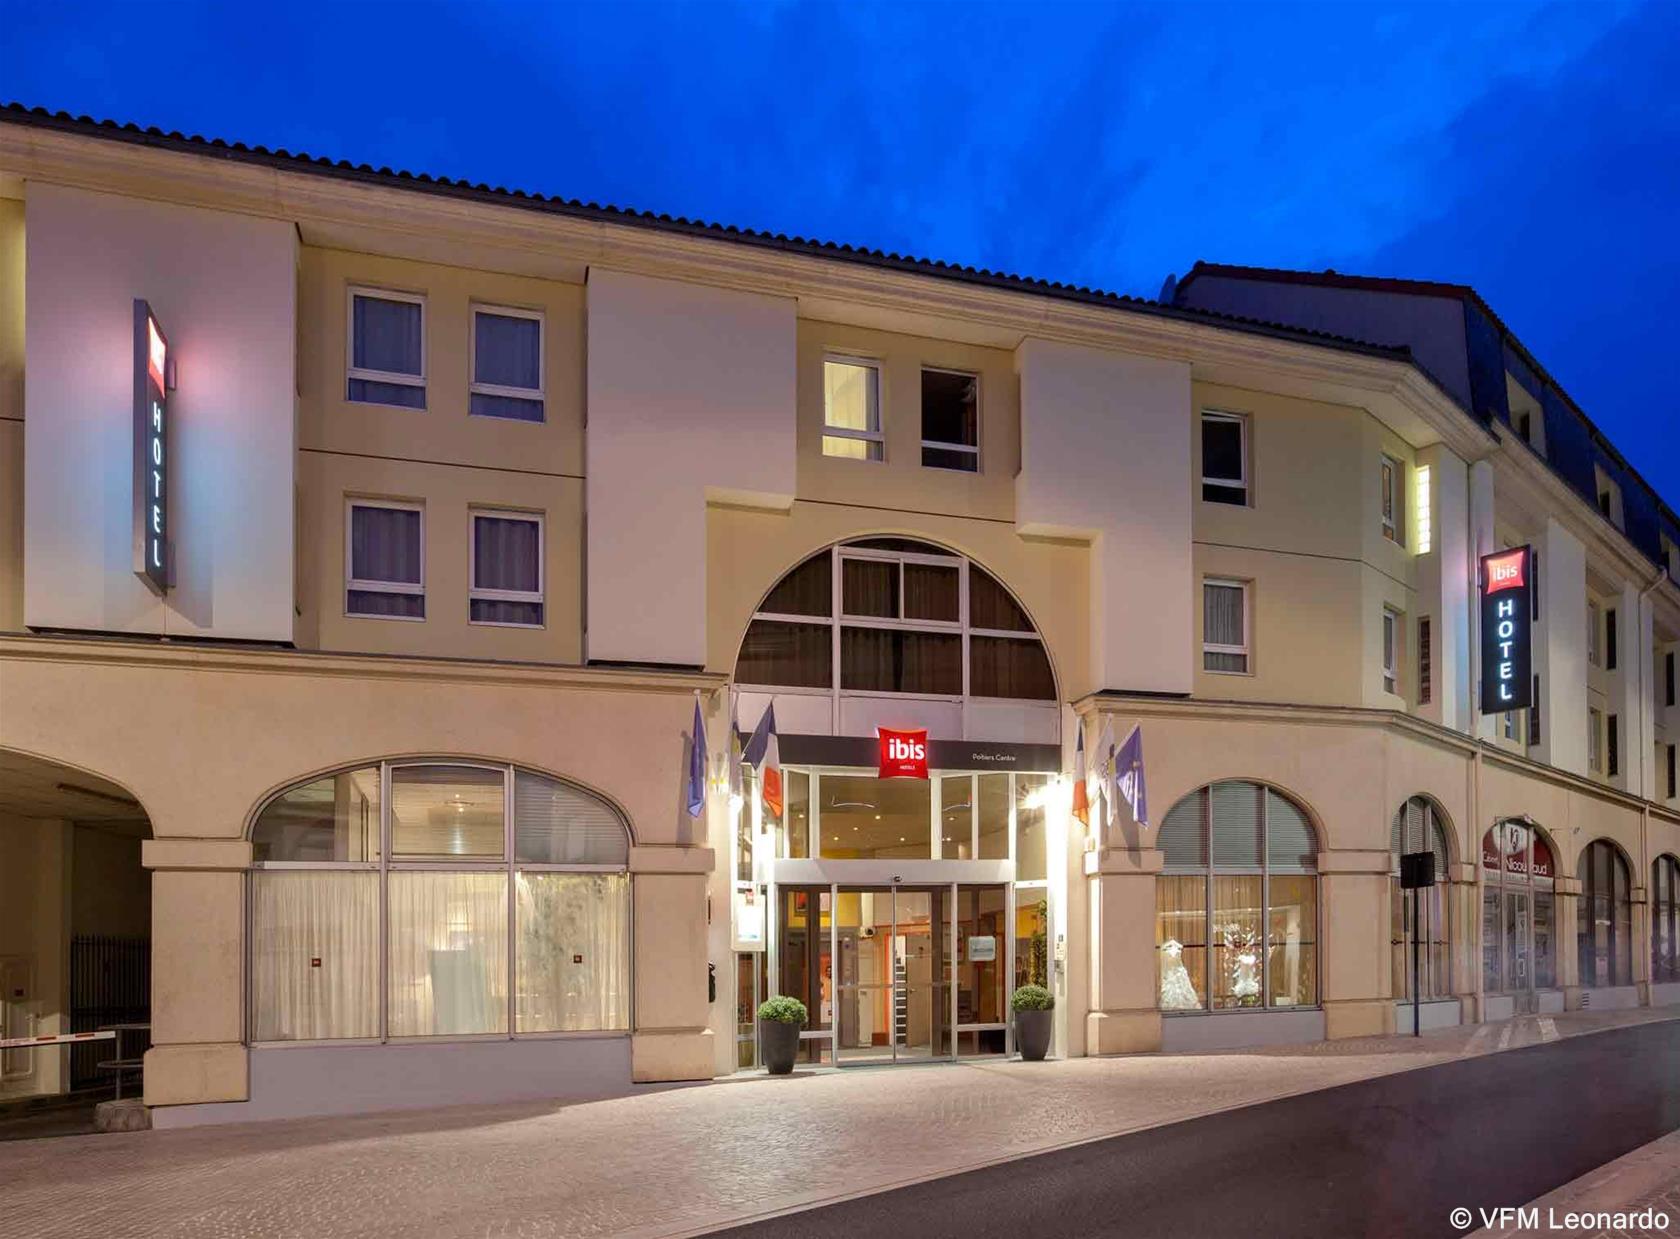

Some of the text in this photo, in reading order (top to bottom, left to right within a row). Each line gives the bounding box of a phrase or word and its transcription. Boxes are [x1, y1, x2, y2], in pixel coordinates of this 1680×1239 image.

[152, 400, 162, 567] HOTEL
[1491, 564, 1519, 581] ibis
[1498, 598, 1514, 701] HOTEL
[888, 738, 925, 760] ibis
